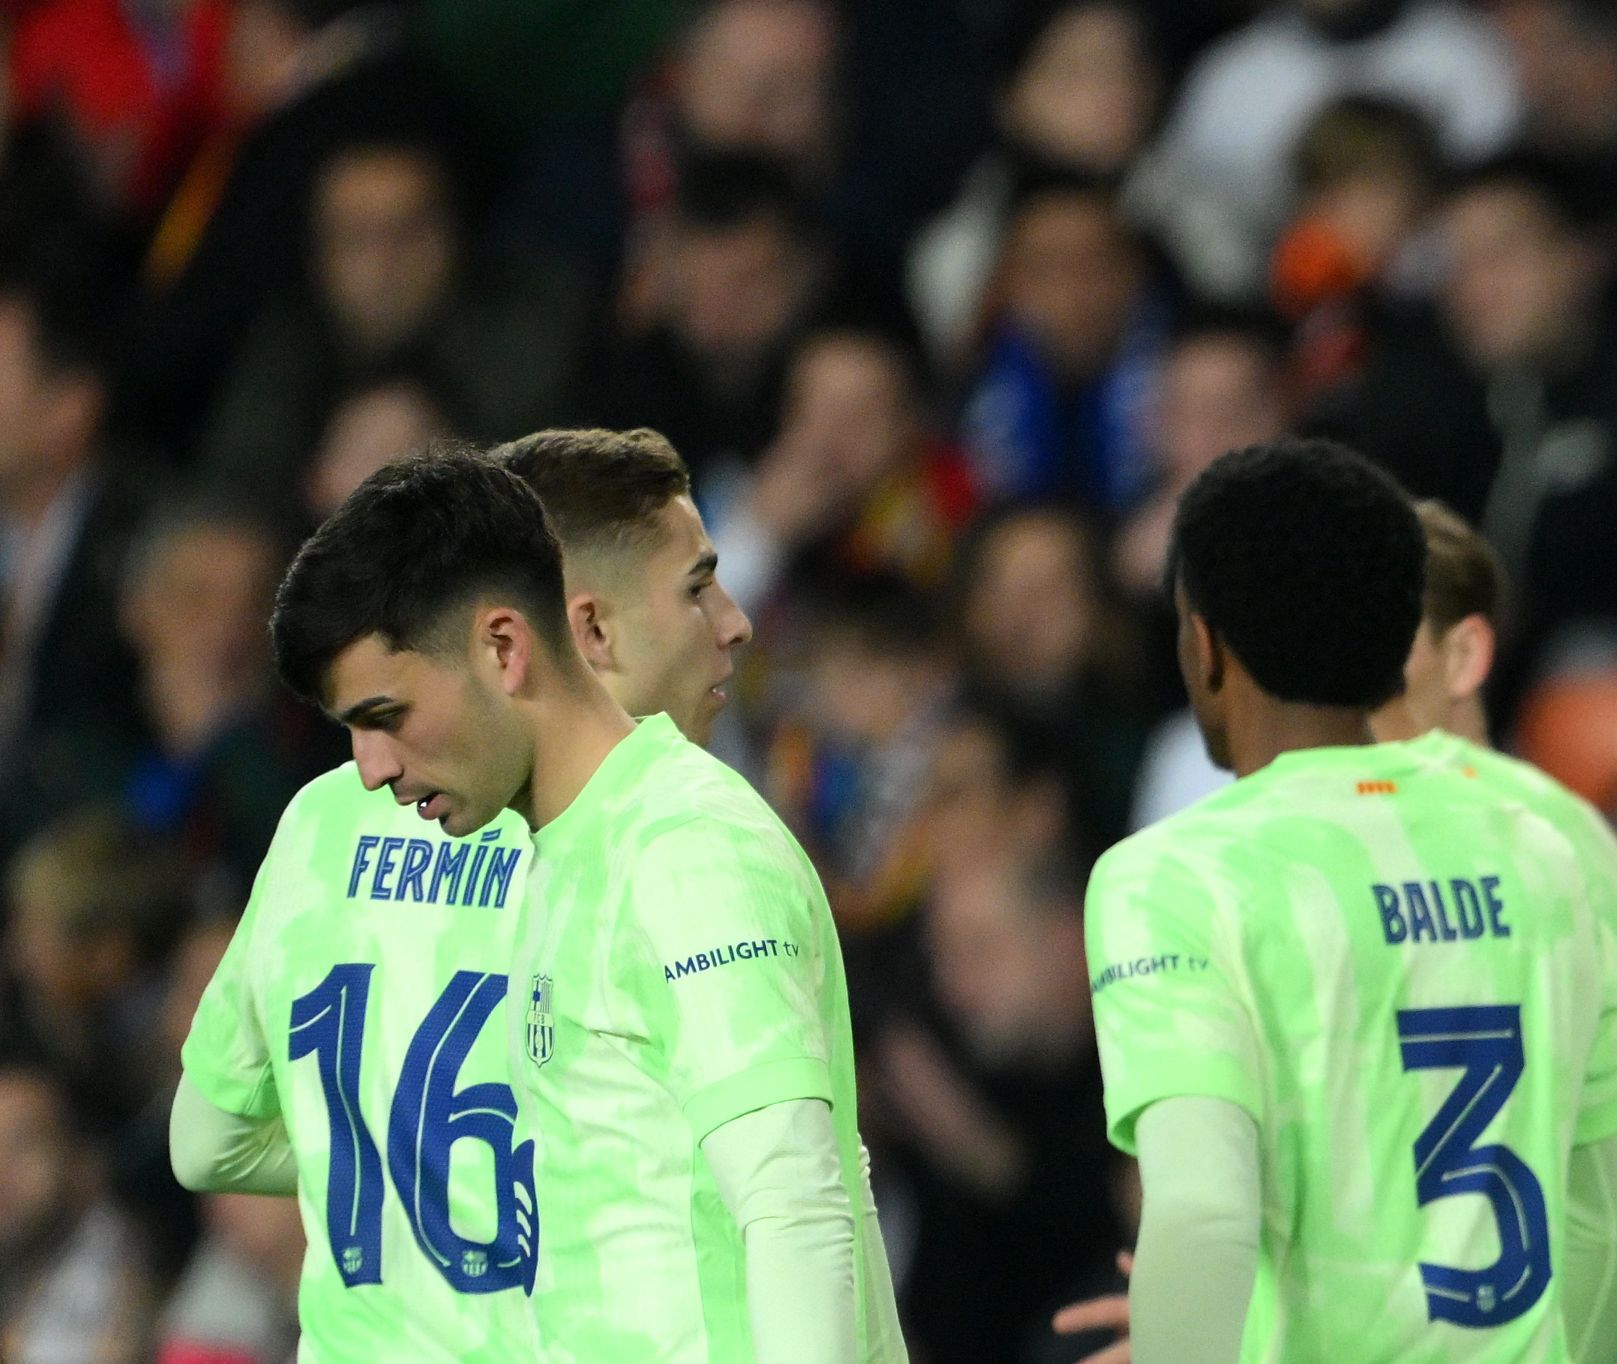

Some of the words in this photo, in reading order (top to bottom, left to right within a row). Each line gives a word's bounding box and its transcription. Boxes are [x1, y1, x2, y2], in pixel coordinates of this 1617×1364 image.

[346, 828, 522, 909] FERMÍN
[1371, 875, 1511, 945] BALDE
[664, 939, 778, 984] AMBILIGHT
[783, 940, 799, 957] tv
[288, 962, 529, 1295] 16
[1396, 1003, 1553, 1330] 3
